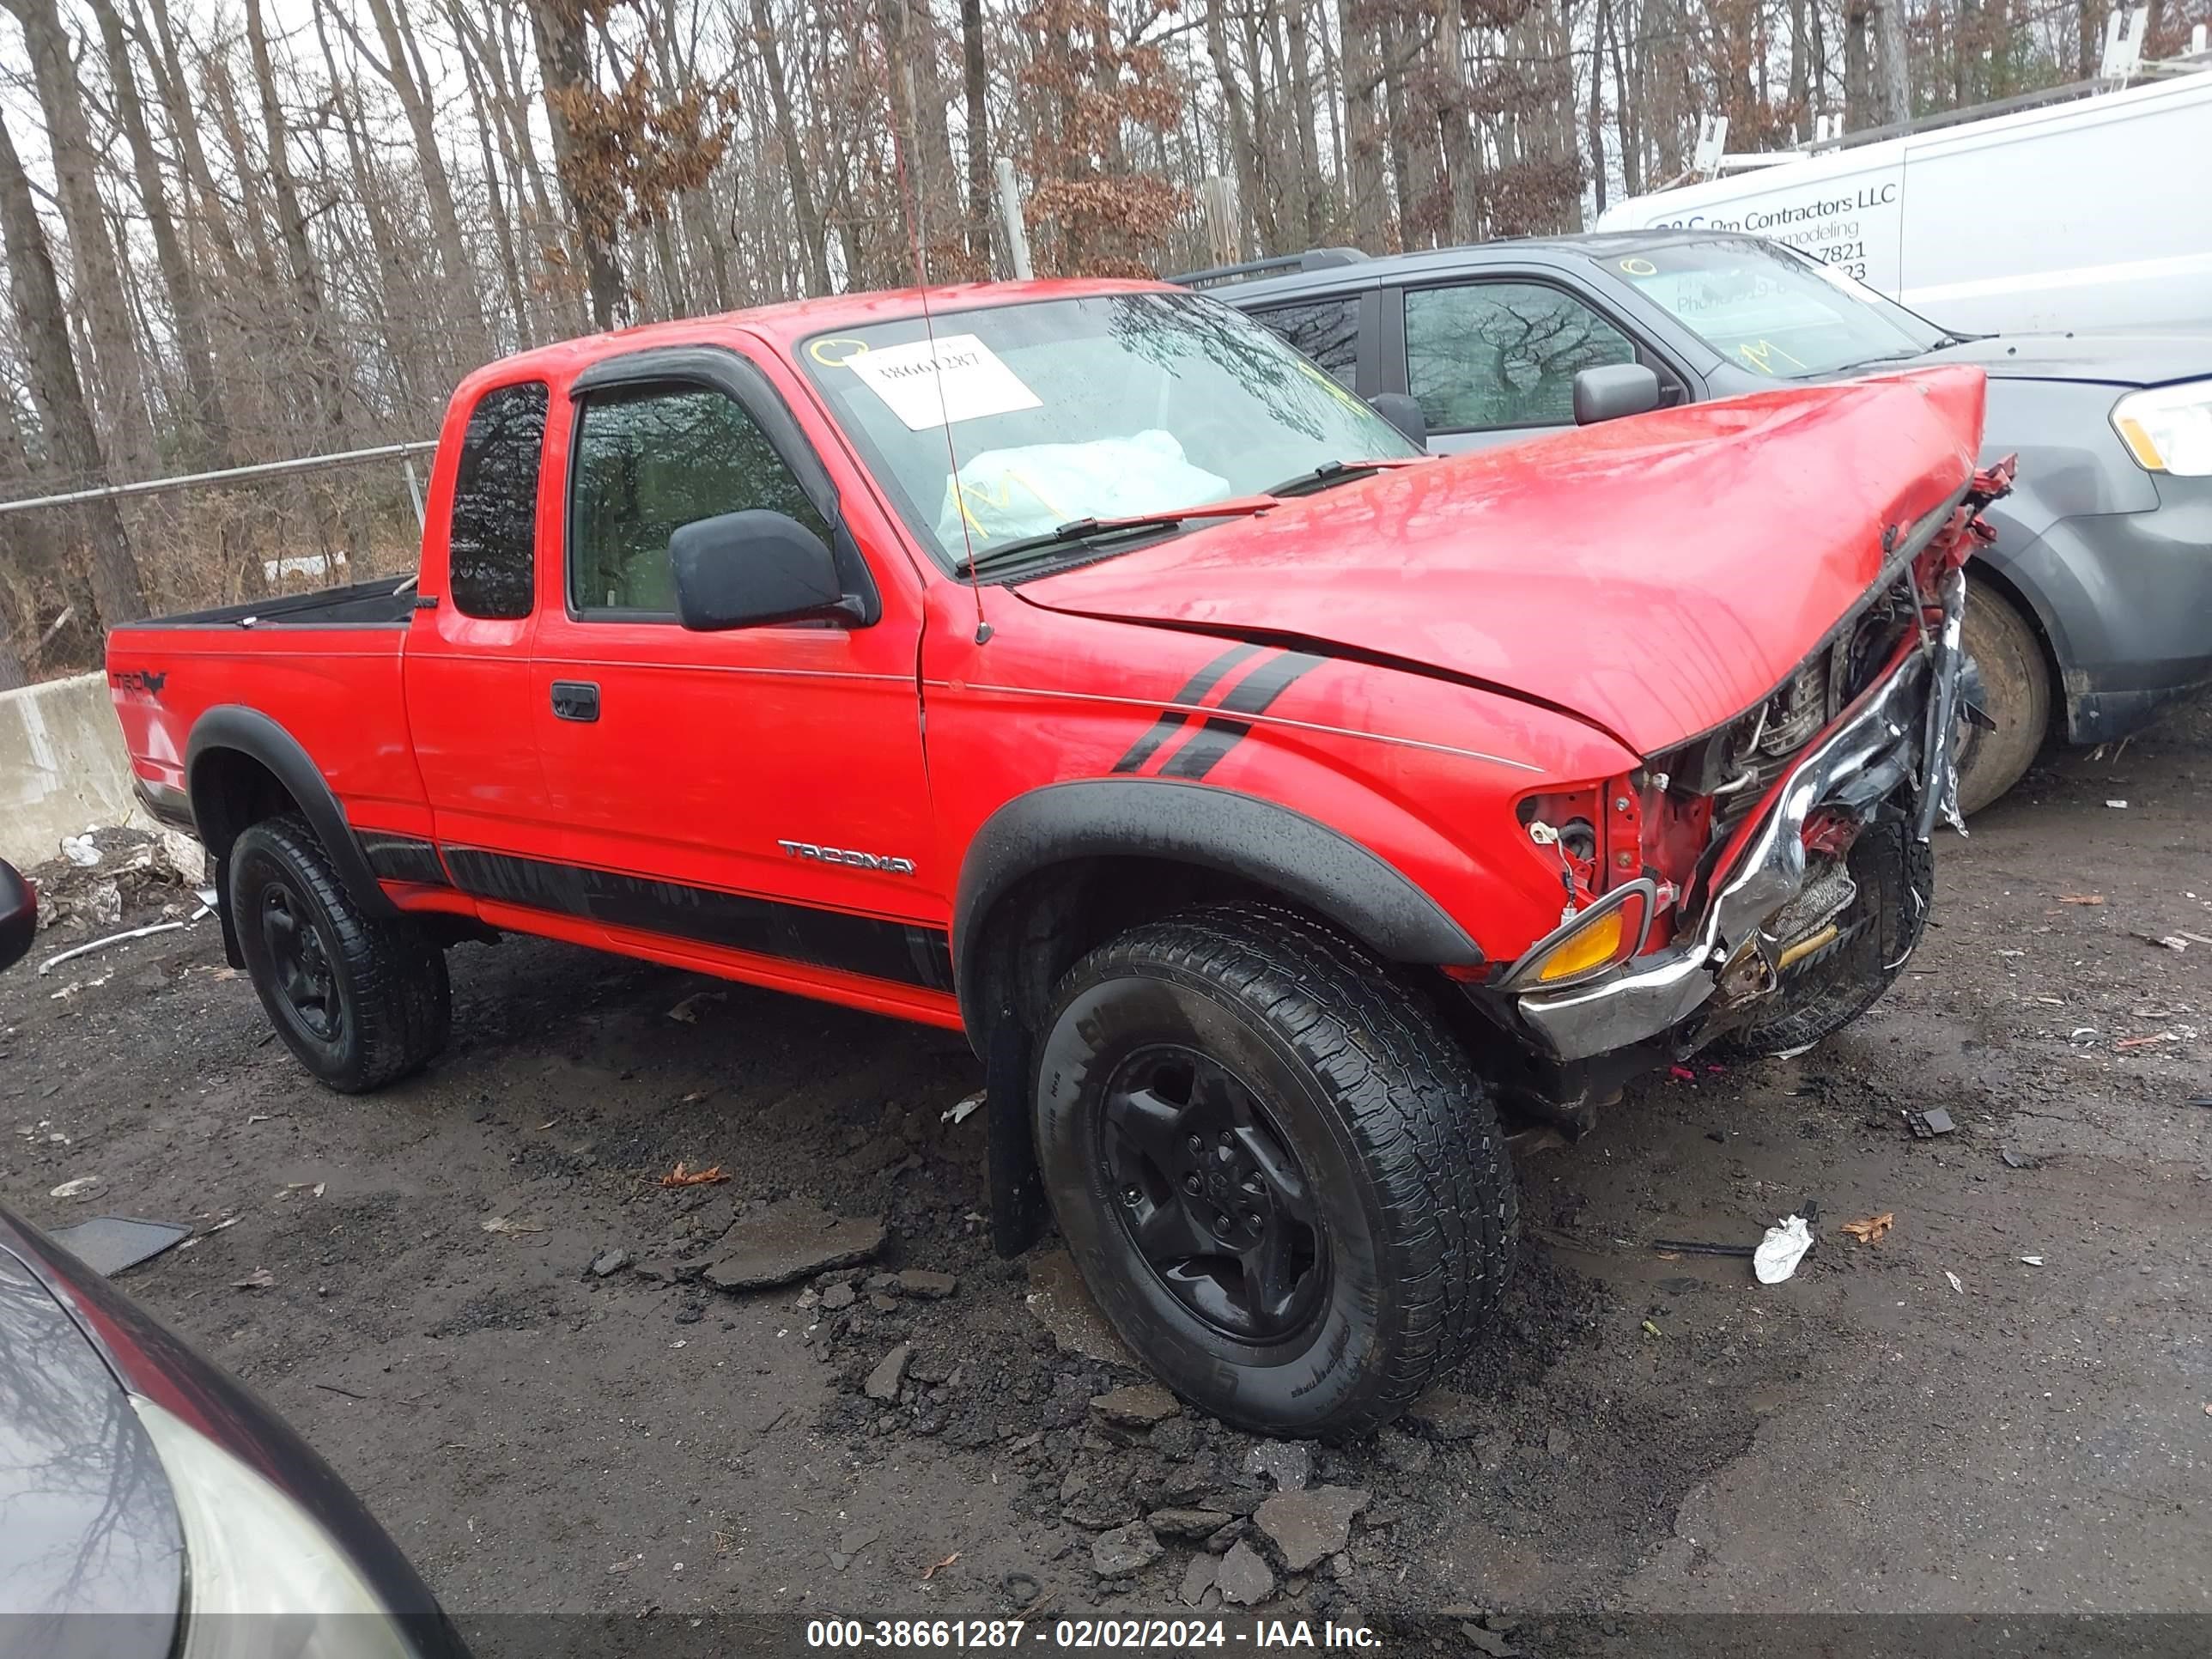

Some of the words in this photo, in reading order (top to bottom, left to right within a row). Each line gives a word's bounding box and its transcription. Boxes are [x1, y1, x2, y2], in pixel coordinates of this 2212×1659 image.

[1745, 196, 1853, 231] Contractors
[1857, 184, 1897, 209] LLC
[1818, 241, 1867, 263] 7821
[776, 839, 917, 877] TACOMA
